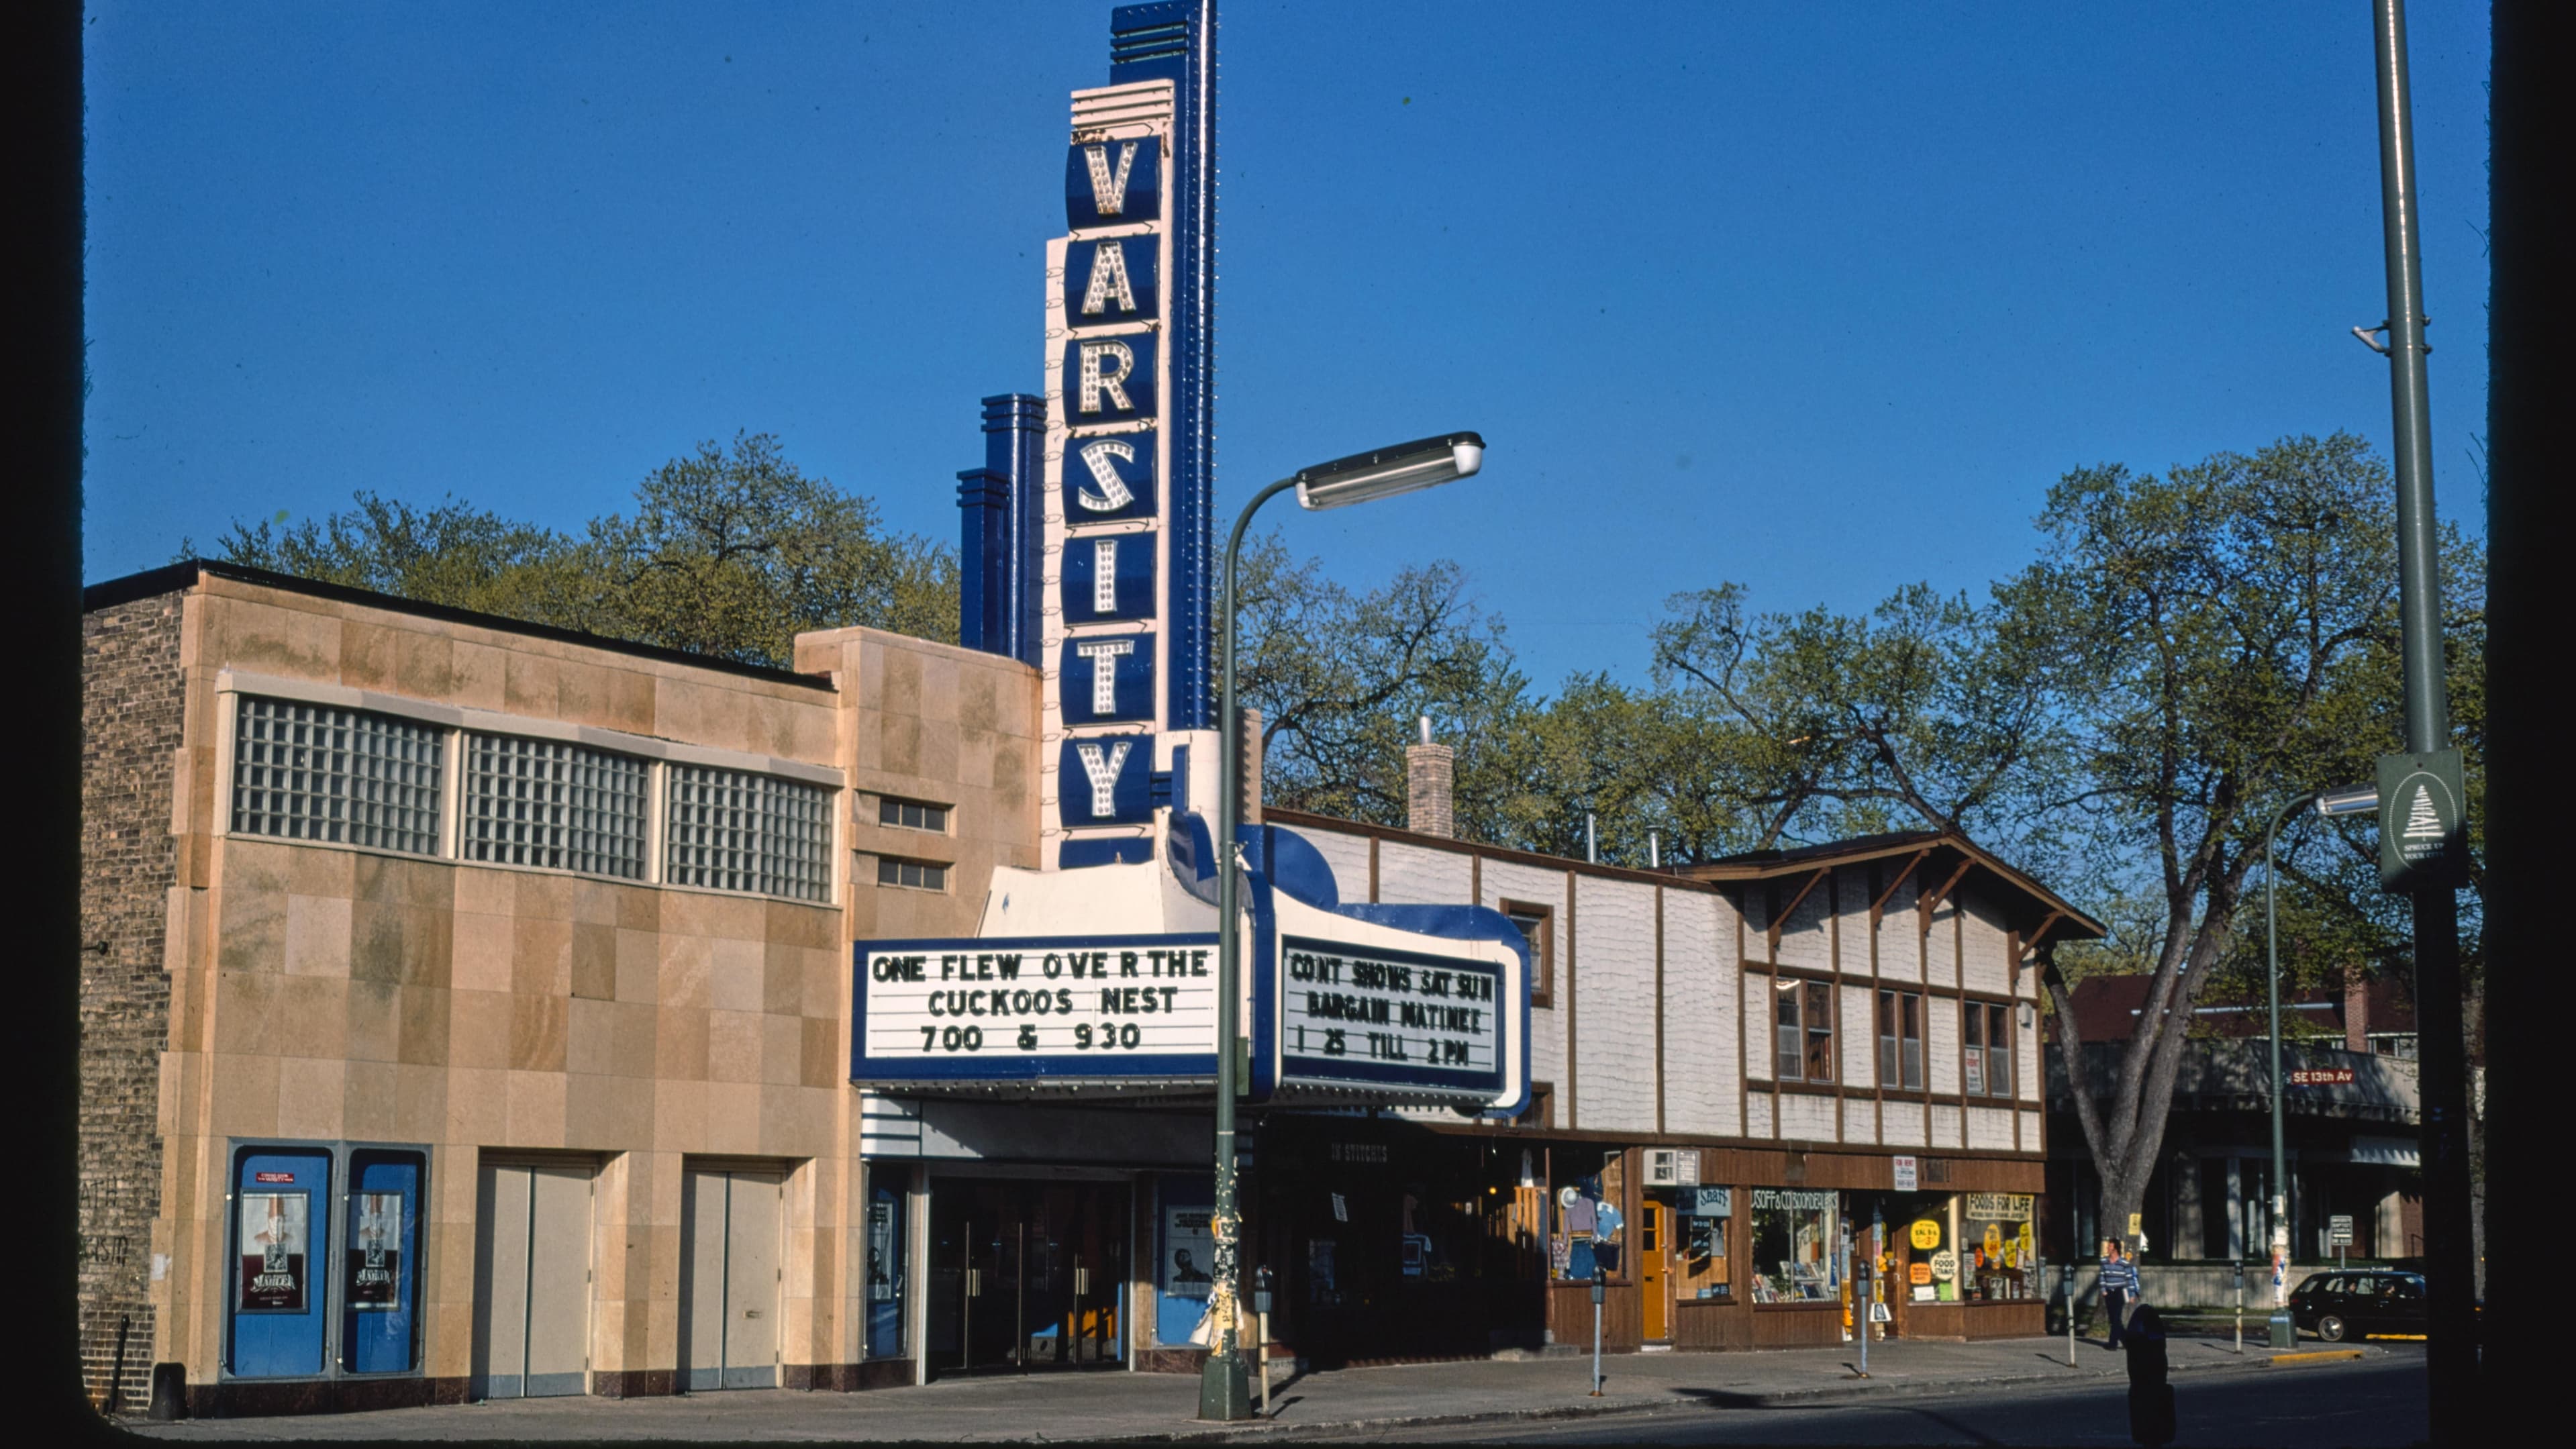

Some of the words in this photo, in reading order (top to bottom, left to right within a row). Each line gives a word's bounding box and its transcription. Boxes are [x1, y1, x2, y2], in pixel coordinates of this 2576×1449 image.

[1077, 140, 1140, 817] VARSITY
[872, 956, 926, 983] ONE
[941, 954, 1022, 981] FLEW
[1146, 950, 1207, 978] THE
[1291, 953, 1342, 985] CONT
[1352, 960, 1411, 993] SHOWS
[1420, 970, 1452, 999] SAT
[1456, 973, 1492, 1002] SUN
[928, 988, 1073, 1017] CUCKOOS
[1100, 987, 1179, 1015] NEST
[1307, 991, 1389, 1026] BARGAIN
[1401, 1001, 1481, 1035] MATINEE
[1017, 1023, 1038, 1052] &
[1368, 1032, 1407, 1061] TILL
[2293, 1072, 2309, 1082] SE
[2311, 1072, 2334, 1082] 13th
[2336, 1071, 2352, 1081] Av
[1970, 1193, 1995, 1210] FOODS
[1997, 1195, 2010, 1211] FOR
[2014, 1196, 2030, 1212] LIFE
[1934, 1260, 1955, 1268] FOOD
